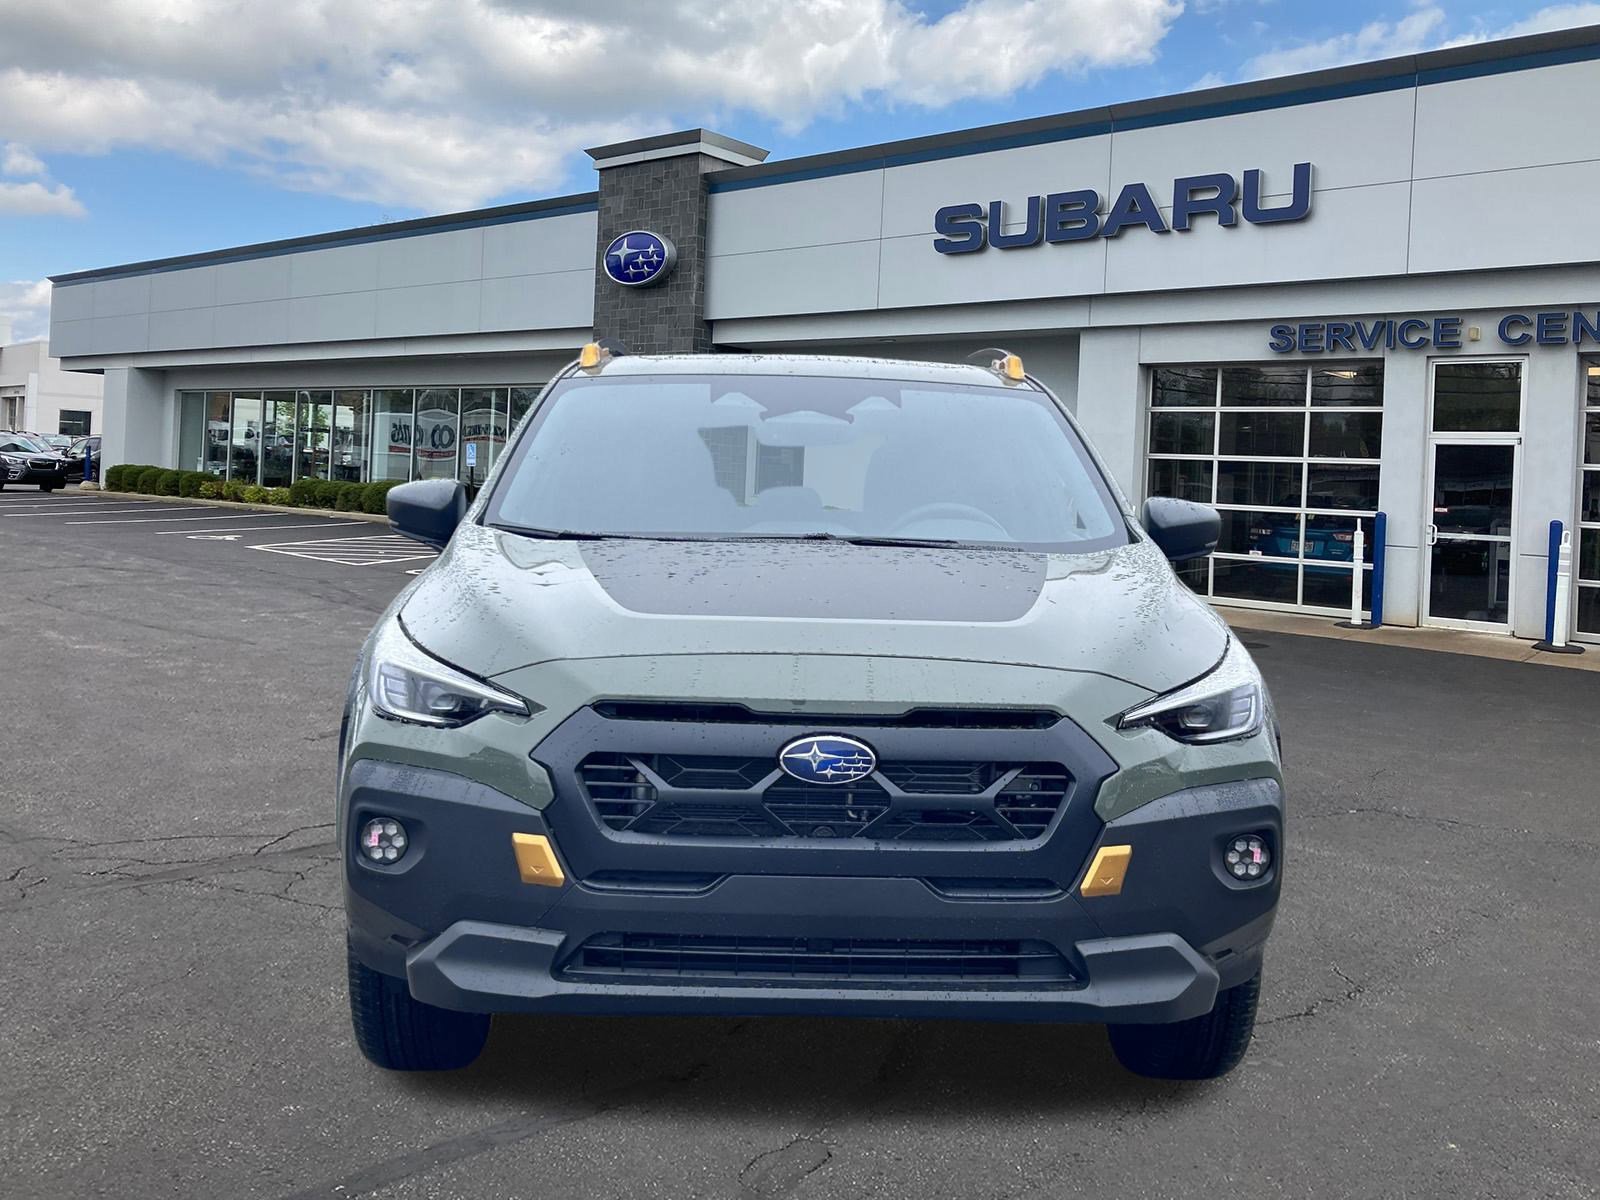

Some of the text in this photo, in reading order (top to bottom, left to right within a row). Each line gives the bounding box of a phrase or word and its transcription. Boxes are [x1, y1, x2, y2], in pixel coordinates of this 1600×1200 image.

[934, 162, 1313, 255] SUBARU
[1269, 311, 1600, 352] SERVICE CEN
